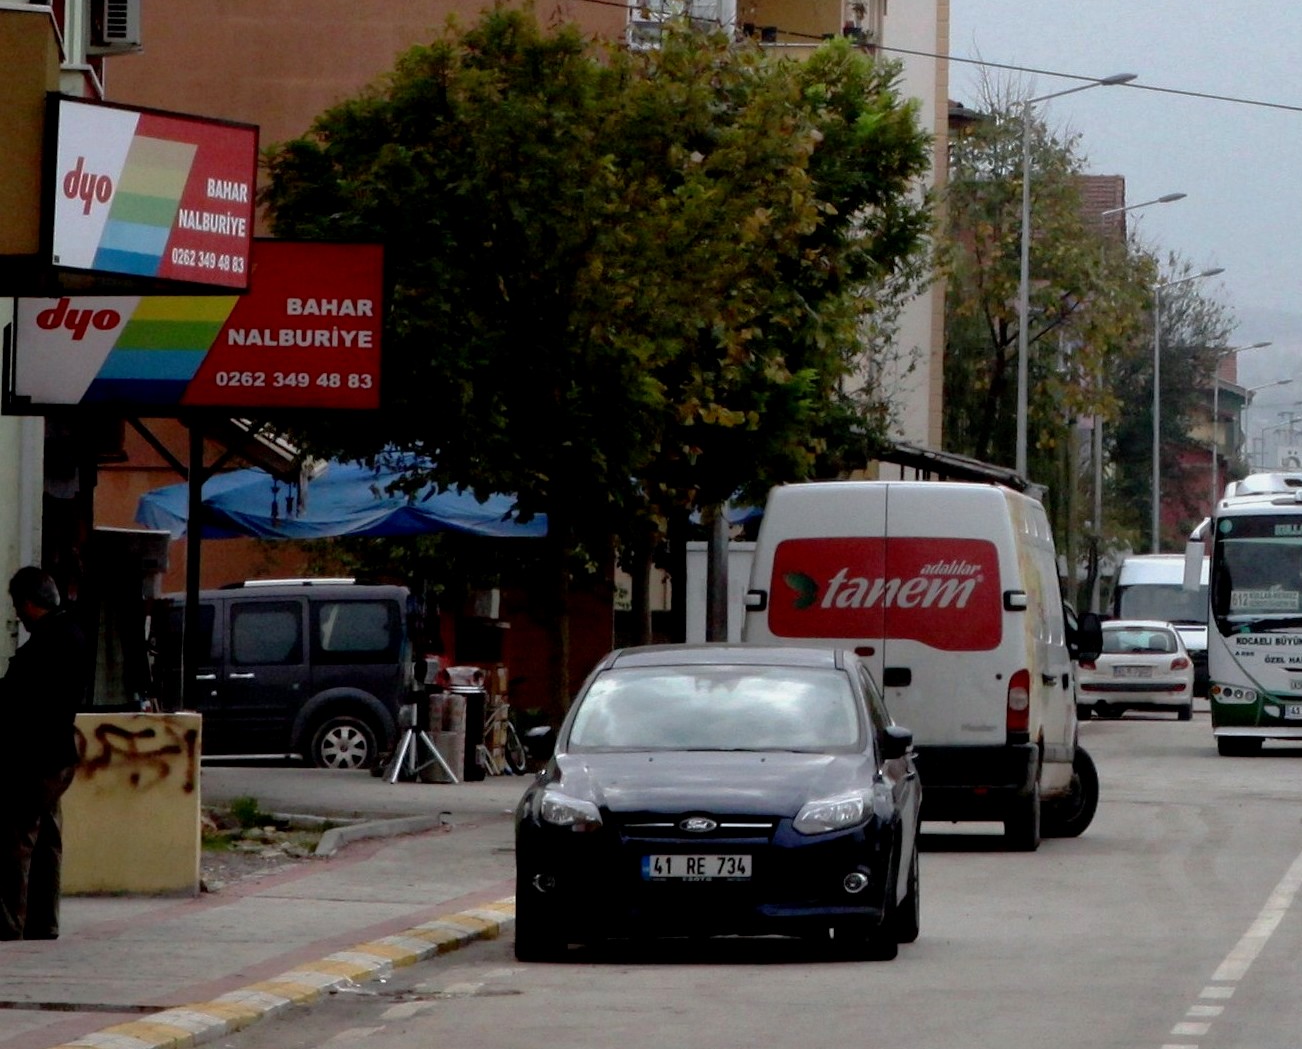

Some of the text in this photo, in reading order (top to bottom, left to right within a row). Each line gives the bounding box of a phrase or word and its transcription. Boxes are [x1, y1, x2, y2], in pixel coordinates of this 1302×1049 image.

[63, 156, 112, 215] dyo
[207, 178, 248, 203] BAHAR
[179, 208, 246, 237] NALBURİYE
[172, 247, 244, 273] 0262 349 48 83
[36, 297, 121, 341] dyo
[286, 297, 374, 317] BAHAR
[227, 326, 373, 348] NALBURİYE
[216, 371, 373, 389] 0262 349 48 83
[820, 567, 977, 609] tanem
[654, 857, 746, 875] 41 RE 734
